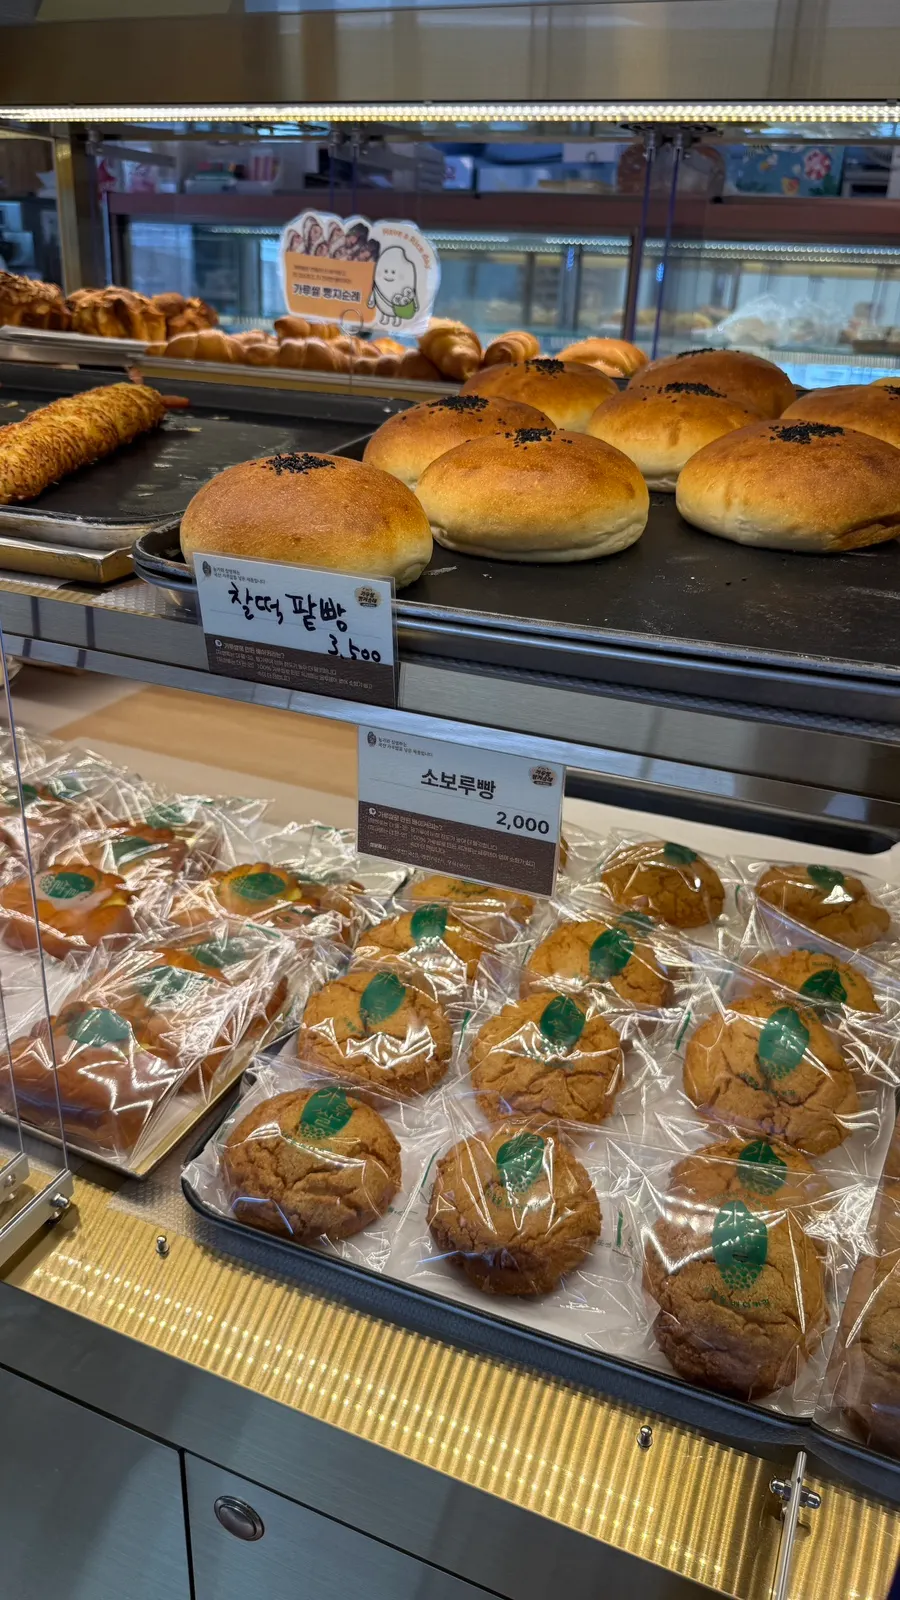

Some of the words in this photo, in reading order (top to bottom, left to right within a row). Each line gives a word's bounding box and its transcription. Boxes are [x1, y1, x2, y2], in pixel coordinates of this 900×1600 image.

[293, 284, 321, 298] 가루쌀
[323, 287, 361, 302] 빵지순례
[420, 769, 496, 800] 소보루빵
[496, 811, 549, 834] 2,000
